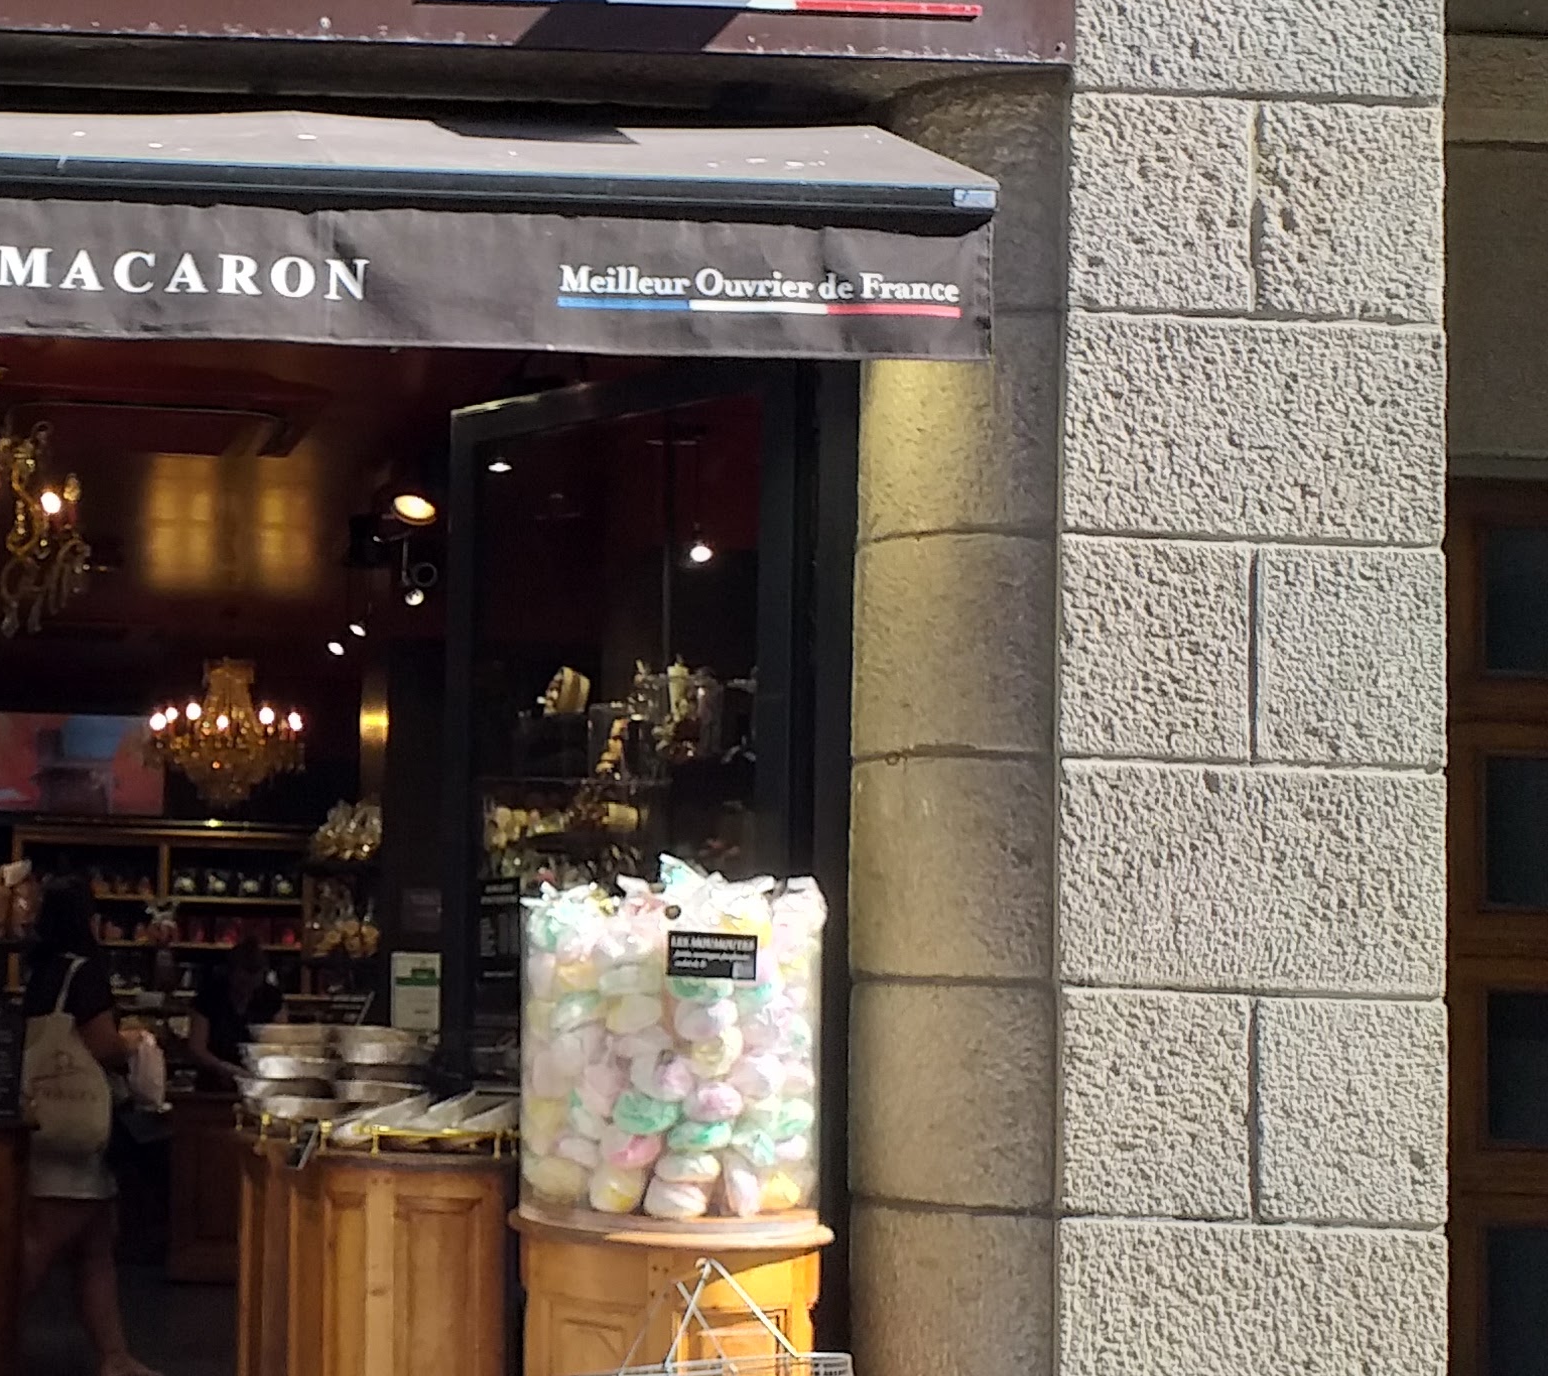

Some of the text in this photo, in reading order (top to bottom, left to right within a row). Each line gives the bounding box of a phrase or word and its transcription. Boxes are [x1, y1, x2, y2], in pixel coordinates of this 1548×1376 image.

[558, 264, 961, 303] Meilleur Ouvrier de France
